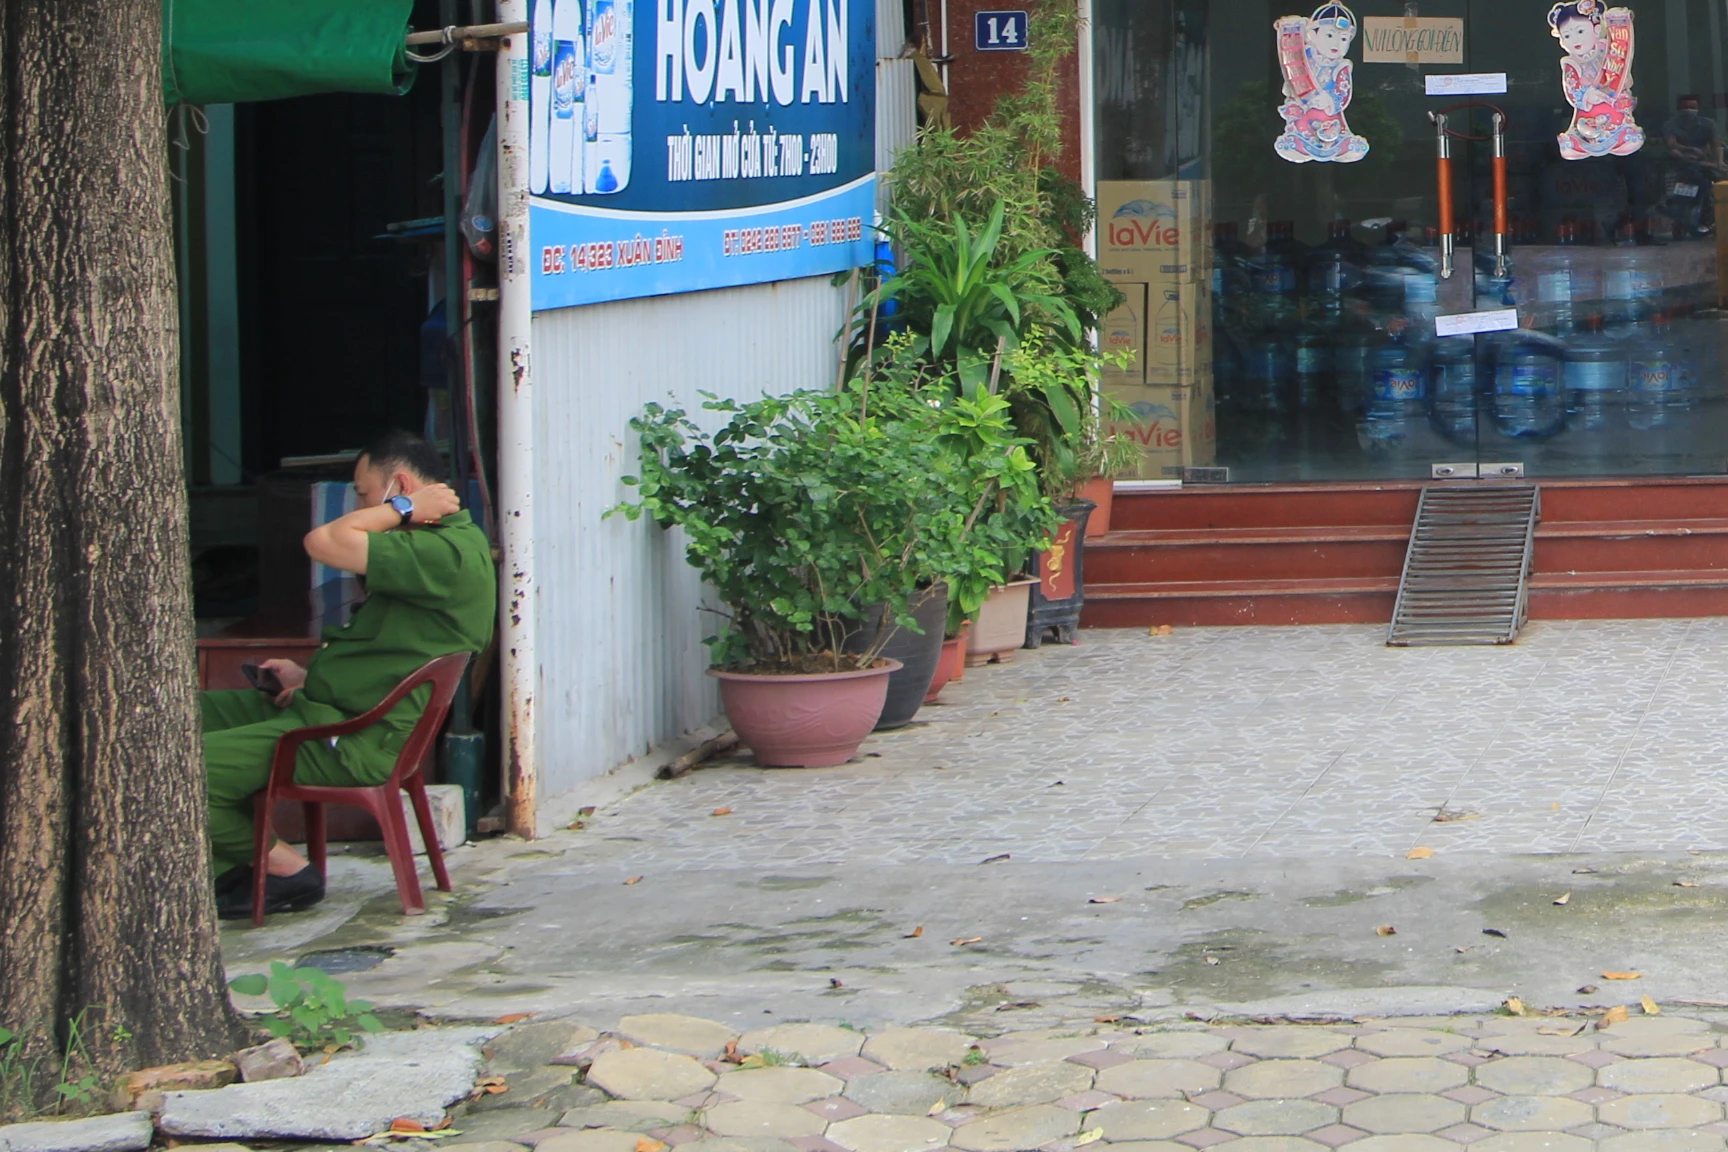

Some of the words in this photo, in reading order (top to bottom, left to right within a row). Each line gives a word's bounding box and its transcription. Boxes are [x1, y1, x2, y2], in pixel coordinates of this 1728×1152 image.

[987, 17, 1018, 44] 14
[667, 123, 693, 182] THỜI
[694, 134, 721, 181] GIAN
[722, 119, 740, 179] MỞ
[741, 119, 762, 179] CỬA
[1109, 219, 1180, 246] laVie
[616, 232, 653, 268] XUÂN
